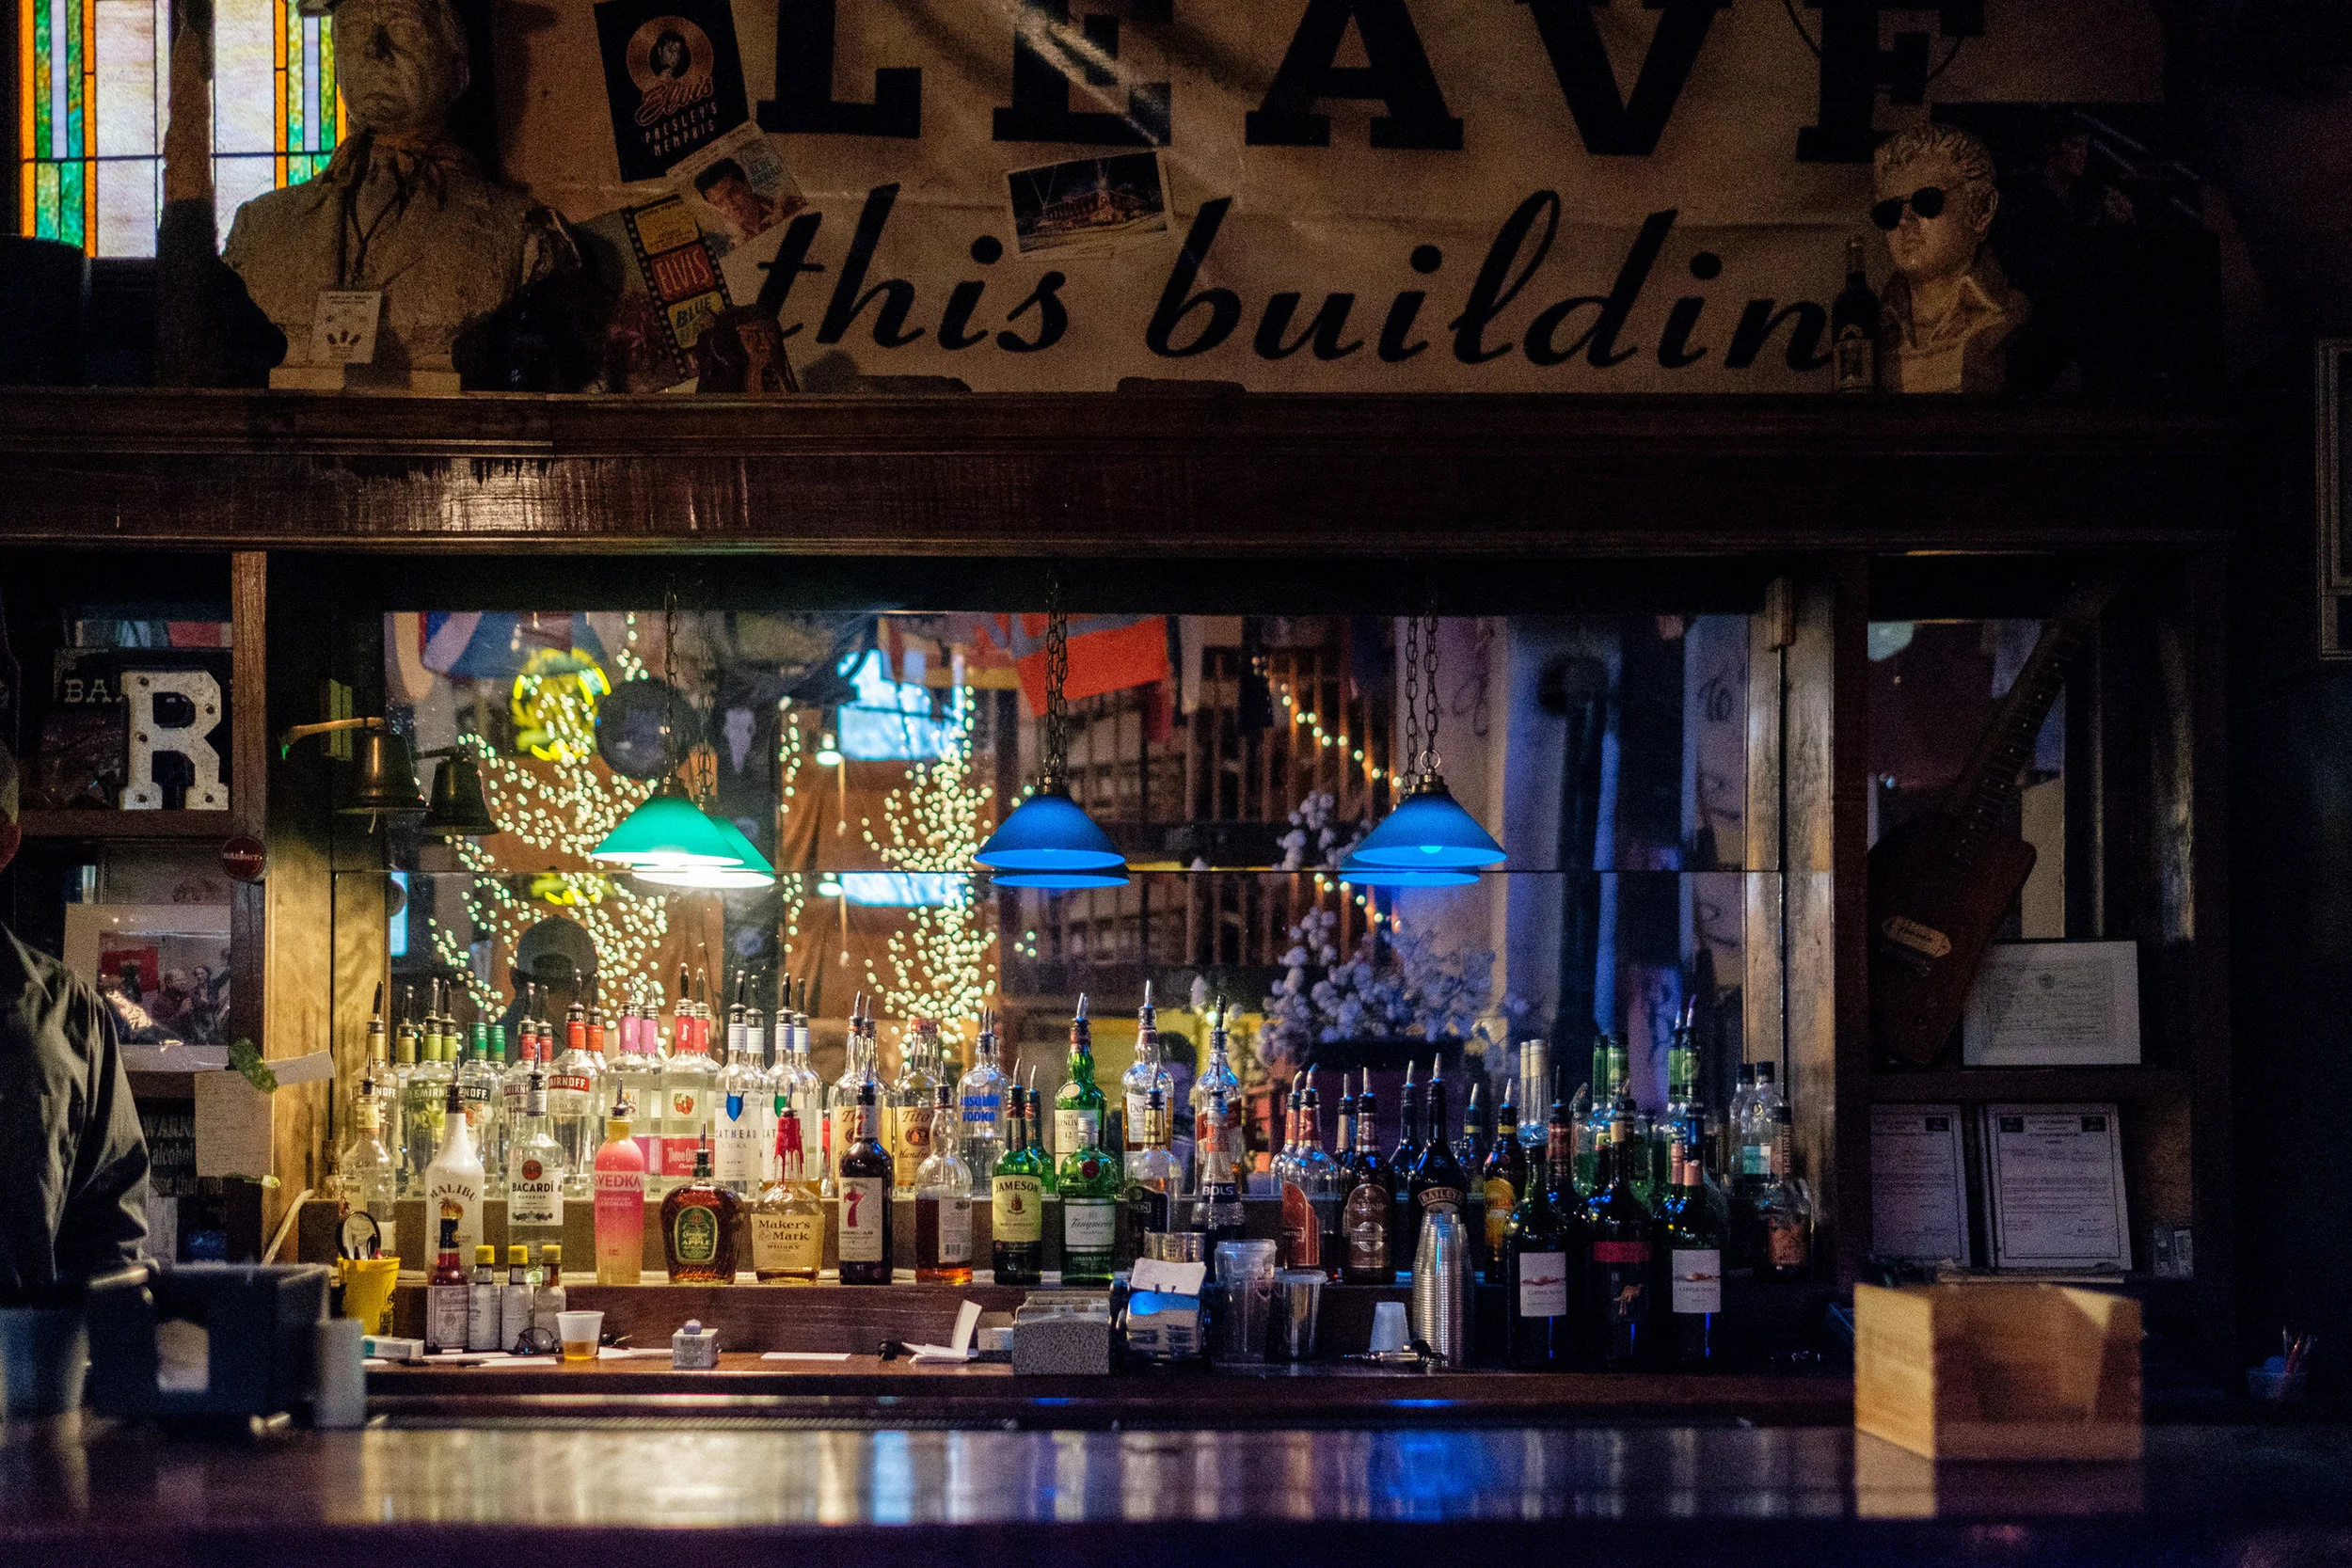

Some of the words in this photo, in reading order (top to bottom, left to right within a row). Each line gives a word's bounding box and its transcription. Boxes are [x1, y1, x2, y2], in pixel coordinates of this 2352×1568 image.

[634, 75, 715, 127] Elvis
[644, 101, 719, 144] PRESLEY'S
[653, 119, 715, 157] MEMPHIS
[656, 248, 711, 293] ELVIS
[755, 184, 1066, 353] this
[1146, 190, 1833, 370] buildin
[675, 298, 711, 328] BLUE
[64, 678, 124, 704] BA
[119, 669, 229, 811] R
[415, 1086, 448, 1098] SMIRN
[504, 1085, 528, 1095] SMIRN
[151, 1142, 194, 1165] alcohol
[429, 1183, 477, 1202] MALIBU
[512, 1180, 554, 1193] BACARDÍ
[994, 1180, 1039, 1194] JAMESON
[1201, 1185, 1234, 1196] BOLS
[1420, 1189, 1464, 1205] BAILEYS
[843, 1187, 866, 1227] 7
[758, 1219, 811, 1229] Maker's
[772, 1231, 810, 1241] Mark
